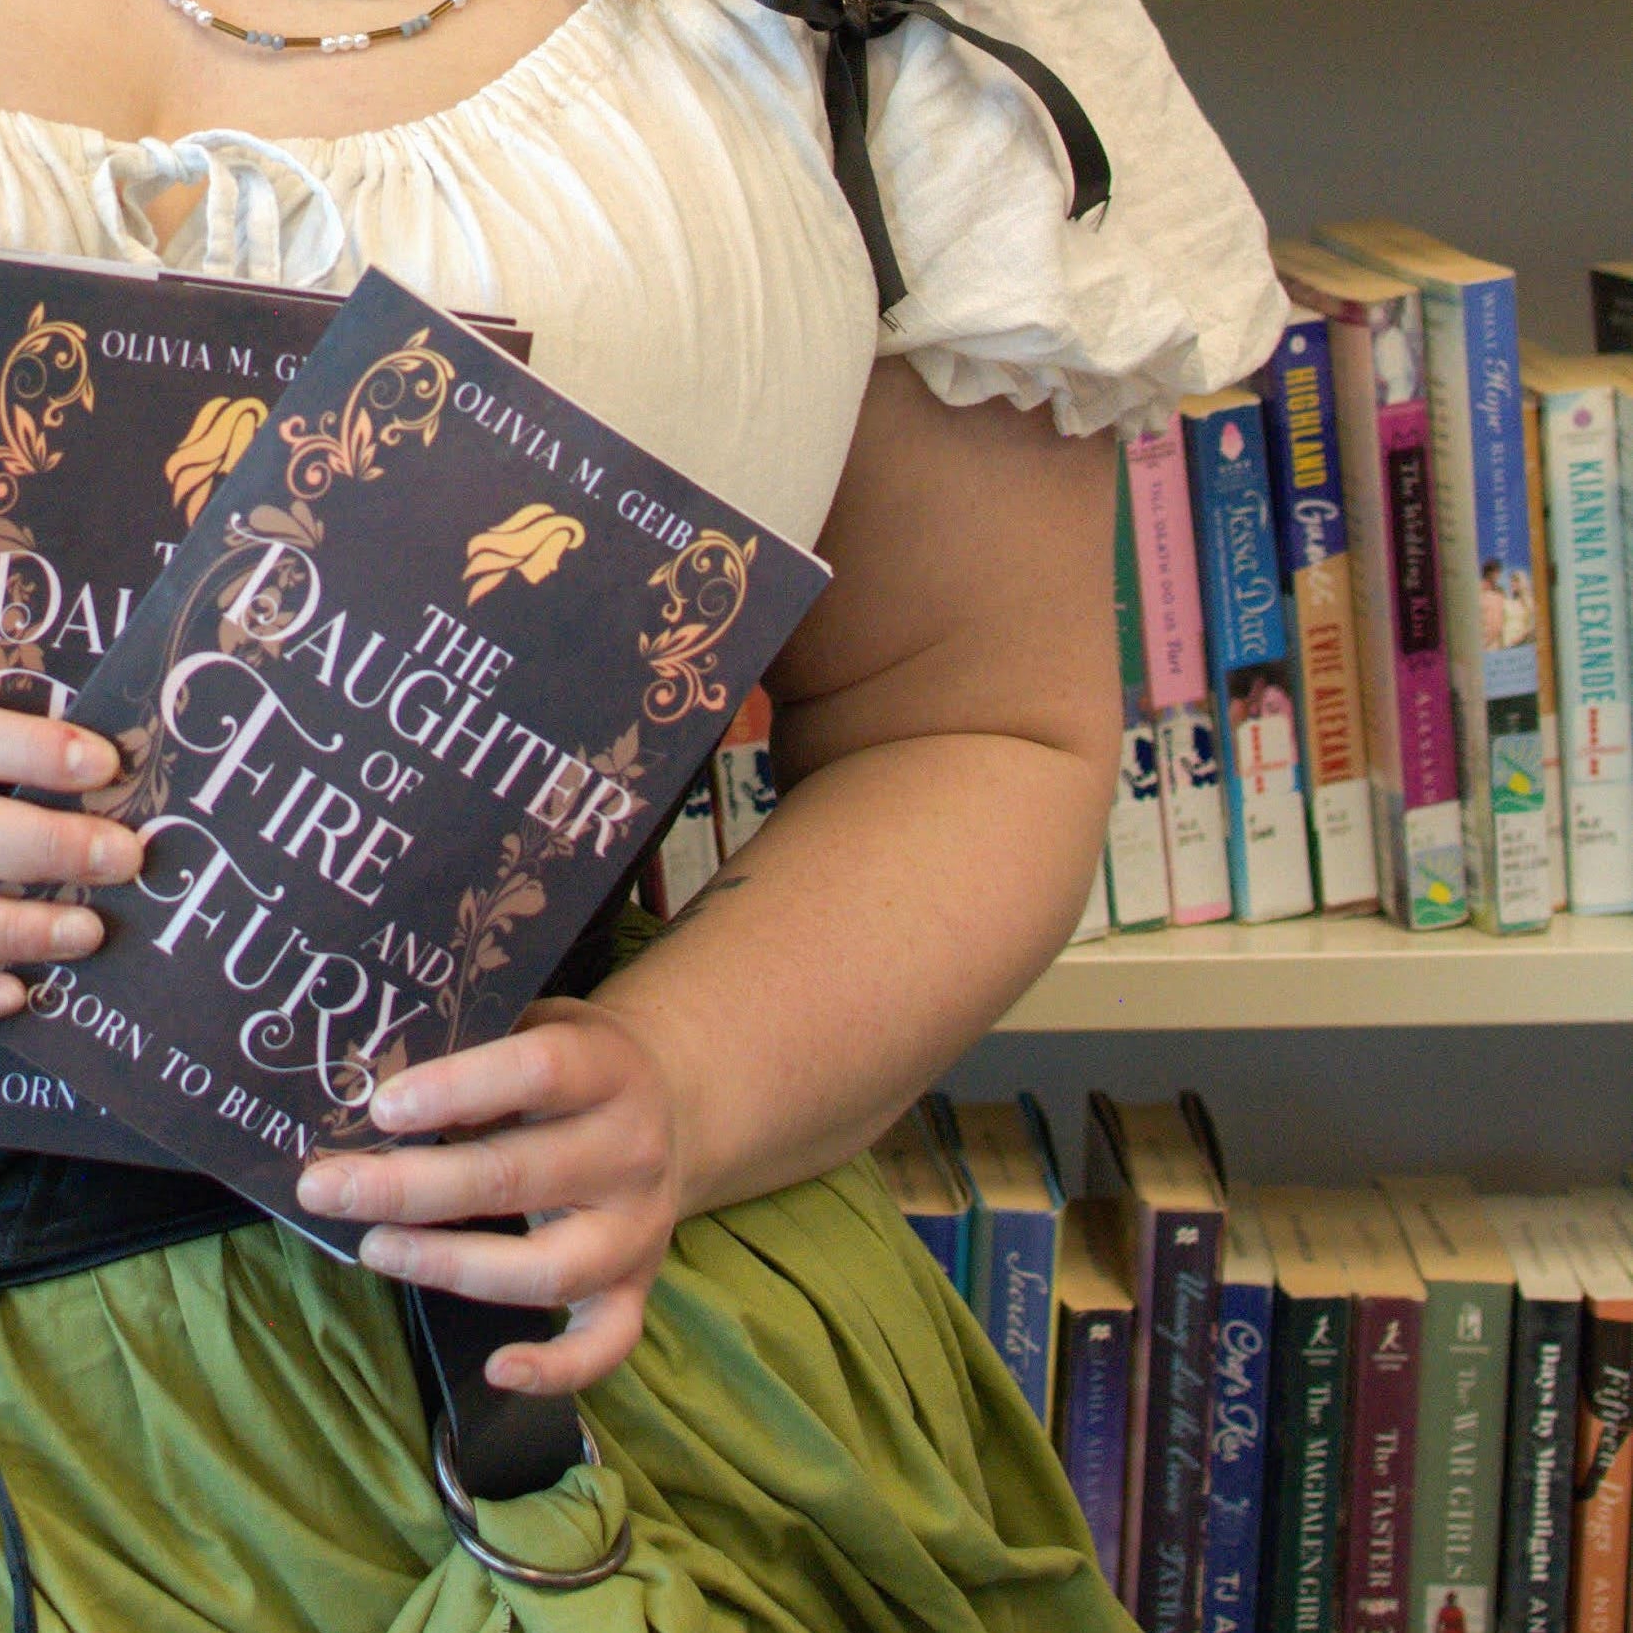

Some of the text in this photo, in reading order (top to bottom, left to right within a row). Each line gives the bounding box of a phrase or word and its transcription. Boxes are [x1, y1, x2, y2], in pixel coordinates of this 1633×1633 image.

[100, 329, 211, 371] OLIVIA
[227, 346, 260, 378] M.
[450, 375, 696, 551] OLIVIA M. GEIB
[1284, 368, 1329, 490] HIGHLAND
[1569, 460, 1605, 565] KIANNA
[227, 508, 635, 861] DAUGHTER
[421, 605, 514, 691] THE
[160, 649, 415, 907] FIRE
[359, 744, 427, 808] OF
[136, 814, 432, 1110] FURY
[361, 920, 456, 991] AND
[27, 964, 319, 1159] BORN TO BURN
[1306, 1385, 1333, 1426] The
[1531, 1343, 1562, 1438] Days by
[1450, 1412, 1478, 1476] WAR
[1369, 1431, 1400, 1593] The TASTER
